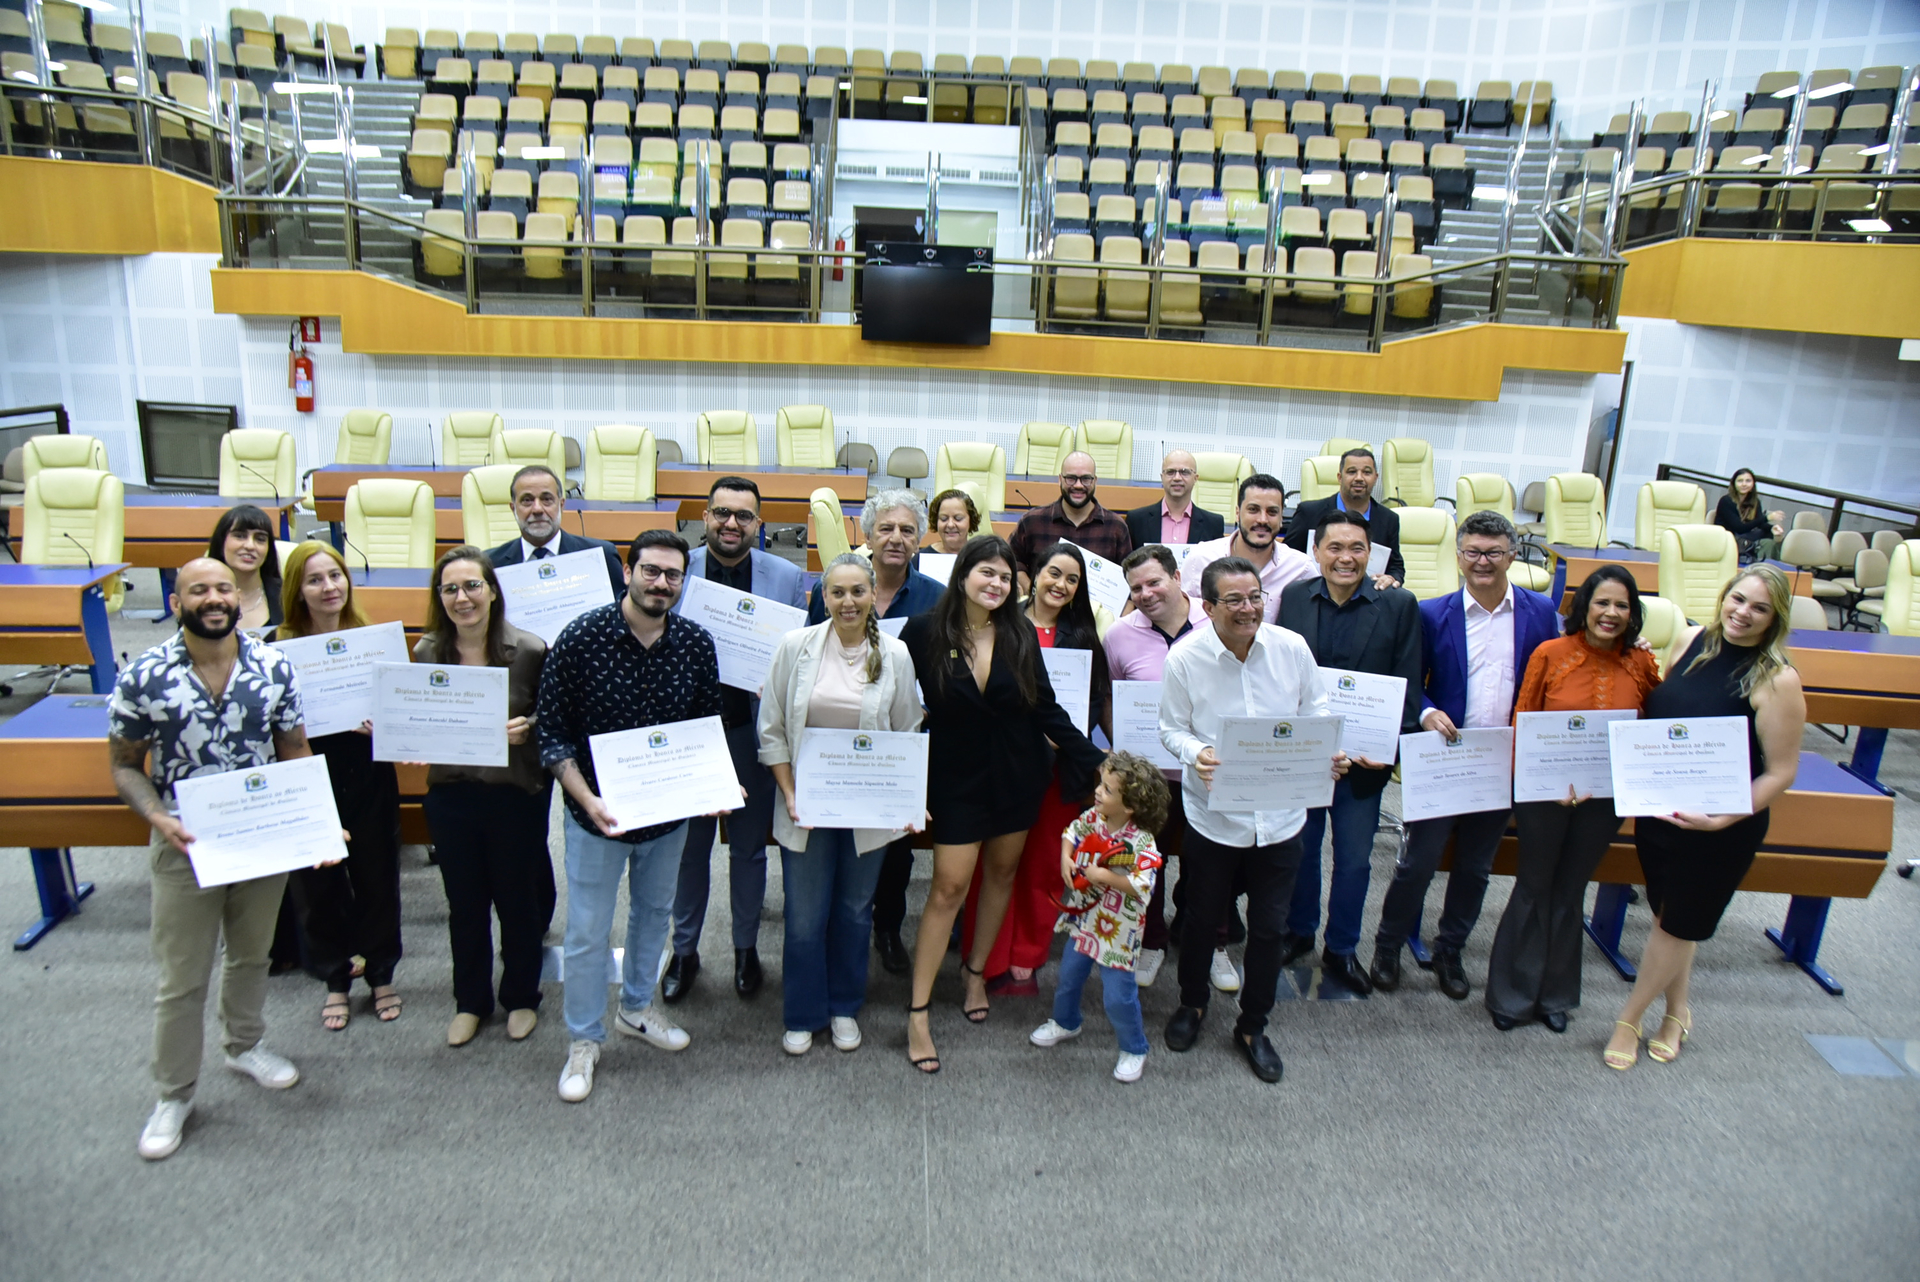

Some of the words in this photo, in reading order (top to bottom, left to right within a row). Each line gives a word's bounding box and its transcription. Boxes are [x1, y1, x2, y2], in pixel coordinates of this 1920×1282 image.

[703, 604, 727, 617] Diploma
[736, 614, 753, 624] Honra
[394, 687, 422, 695] Diploma
[1633, 743, 1661, 751] Diploma
[1671, 742, 1692, 750] Honra
[617, 755, 644, 764] Diploma
[654, 749, 674, 757] Honra
[684, 743, 705, 752] Mérito
[819, 752, 845, 760] Diploma
[1448, 748, 1464, 756] Honra
[208, 799, 239, 810] Diploma
[250, 794, 273, 803] Honra
[284, 786, 308, 796] Mérito
